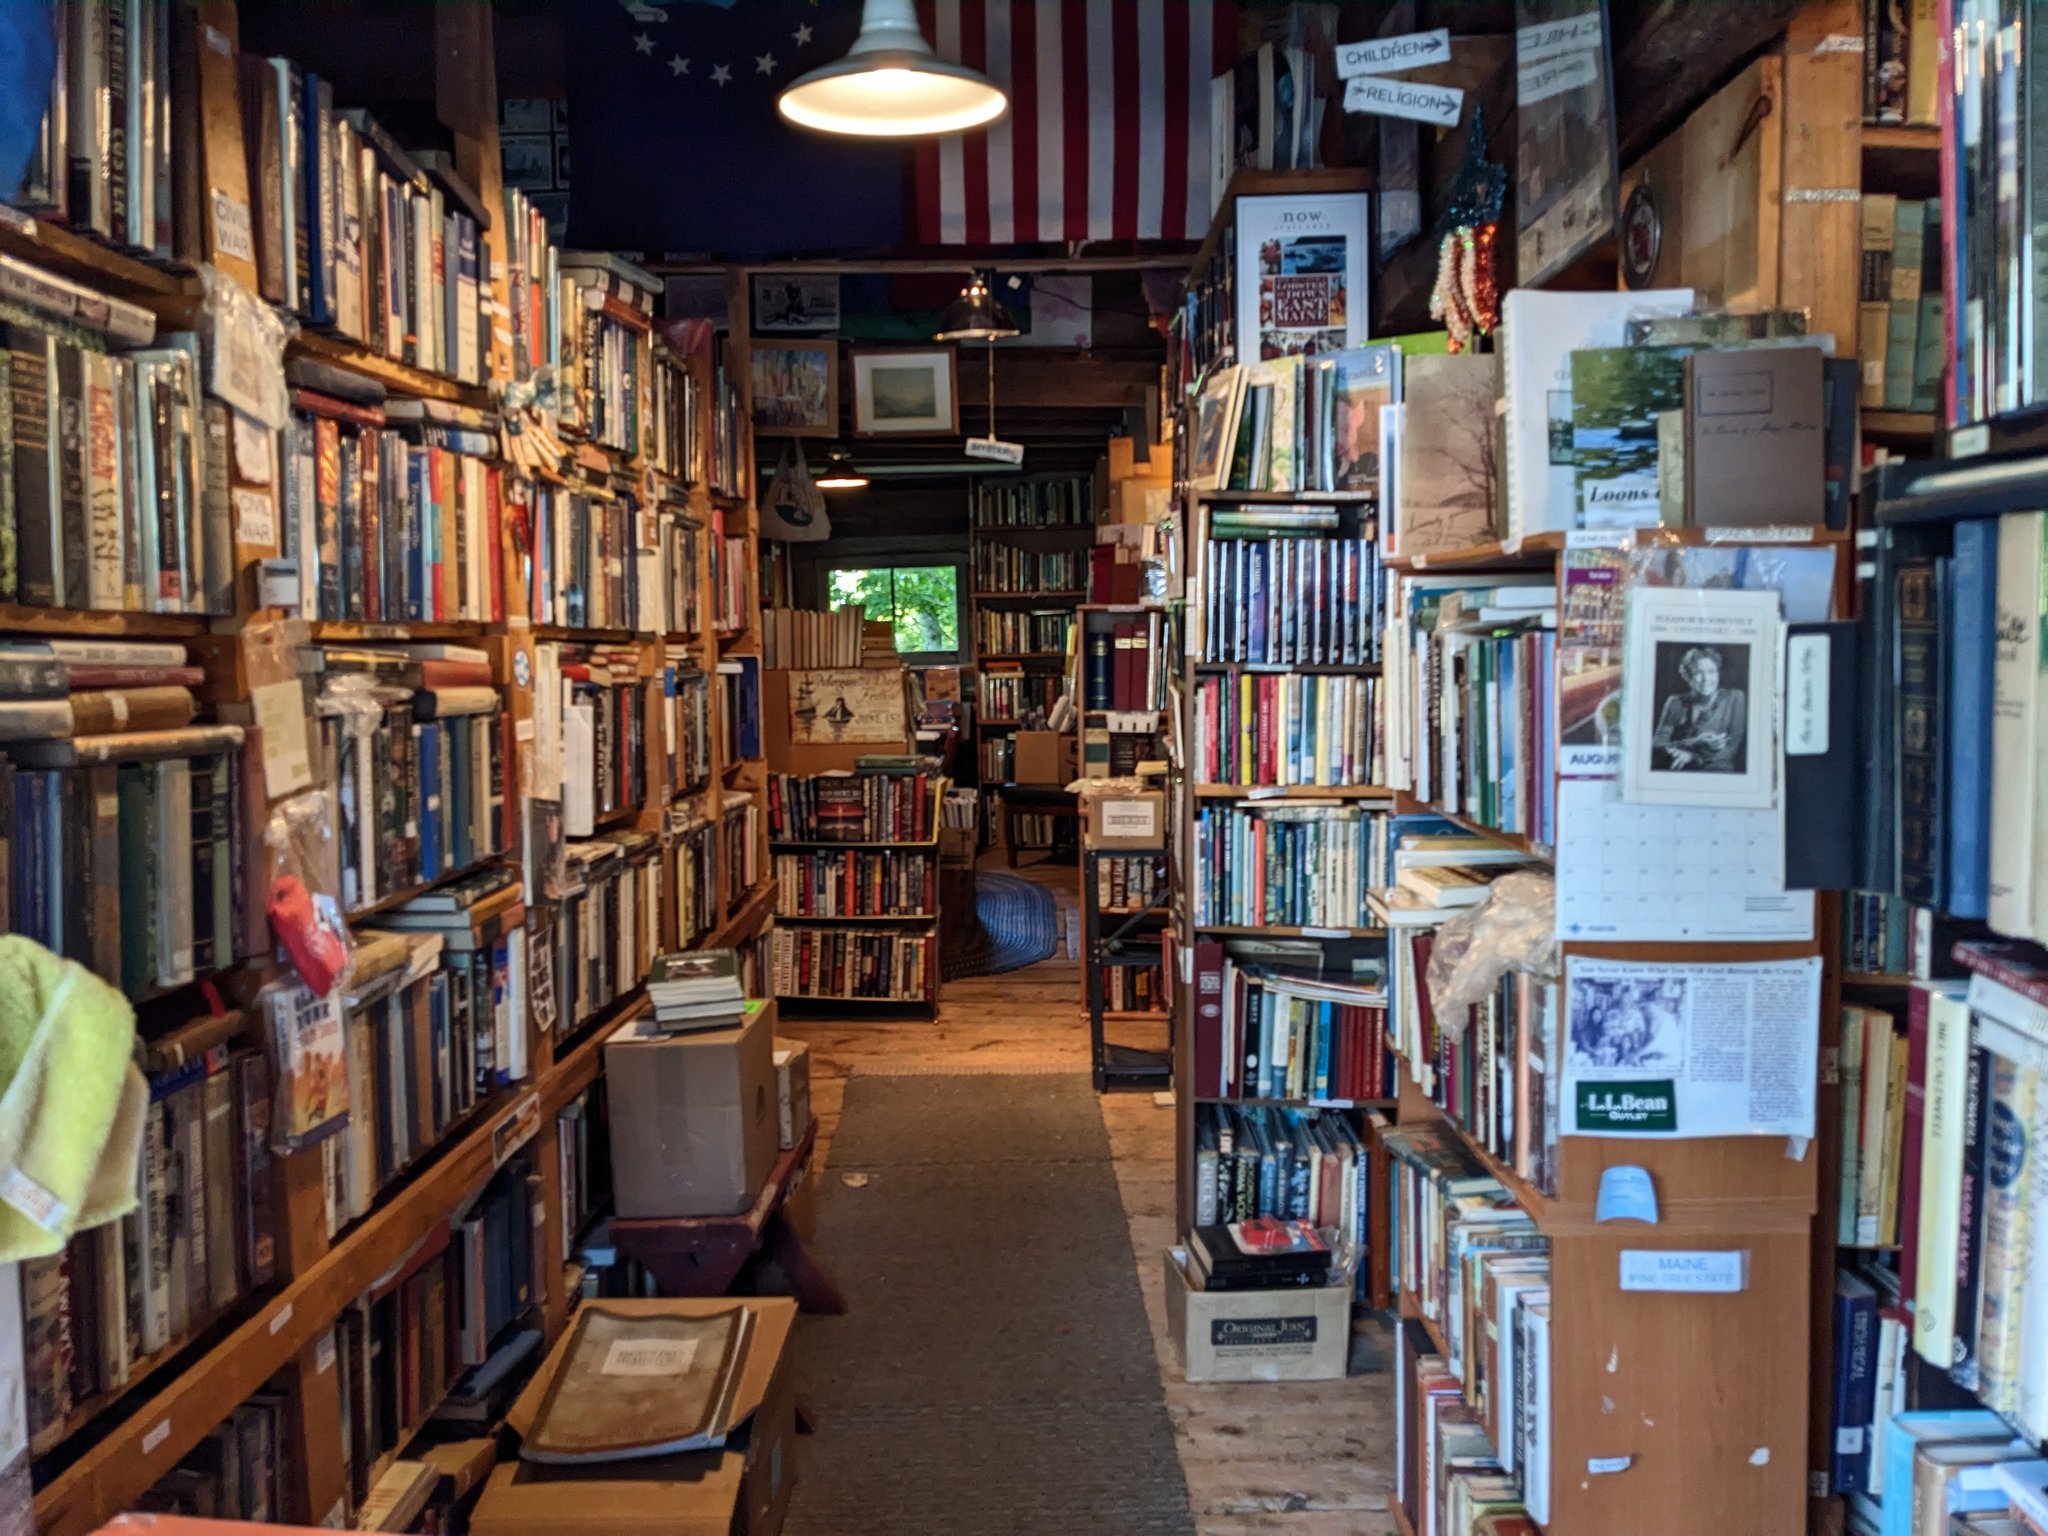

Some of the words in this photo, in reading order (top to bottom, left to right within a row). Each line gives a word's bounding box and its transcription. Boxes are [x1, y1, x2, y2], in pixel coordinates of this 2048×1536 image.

[1345, 41, 1425, 65] CHILDREN
[1366, 86, 1441, 110] RELIGION
[215, 200, 248, 228] CIVIL
[1282, 210, 1322, 222] now
[218, 228, 250, 253] WAR
[1589, 484, 1648, 503] Loons
[242, 516, 274, 544] WAR
[1588, 1093, 1668, 1112] L.L.Bean
[1657, 1257, 1708, 1271] MAINE
